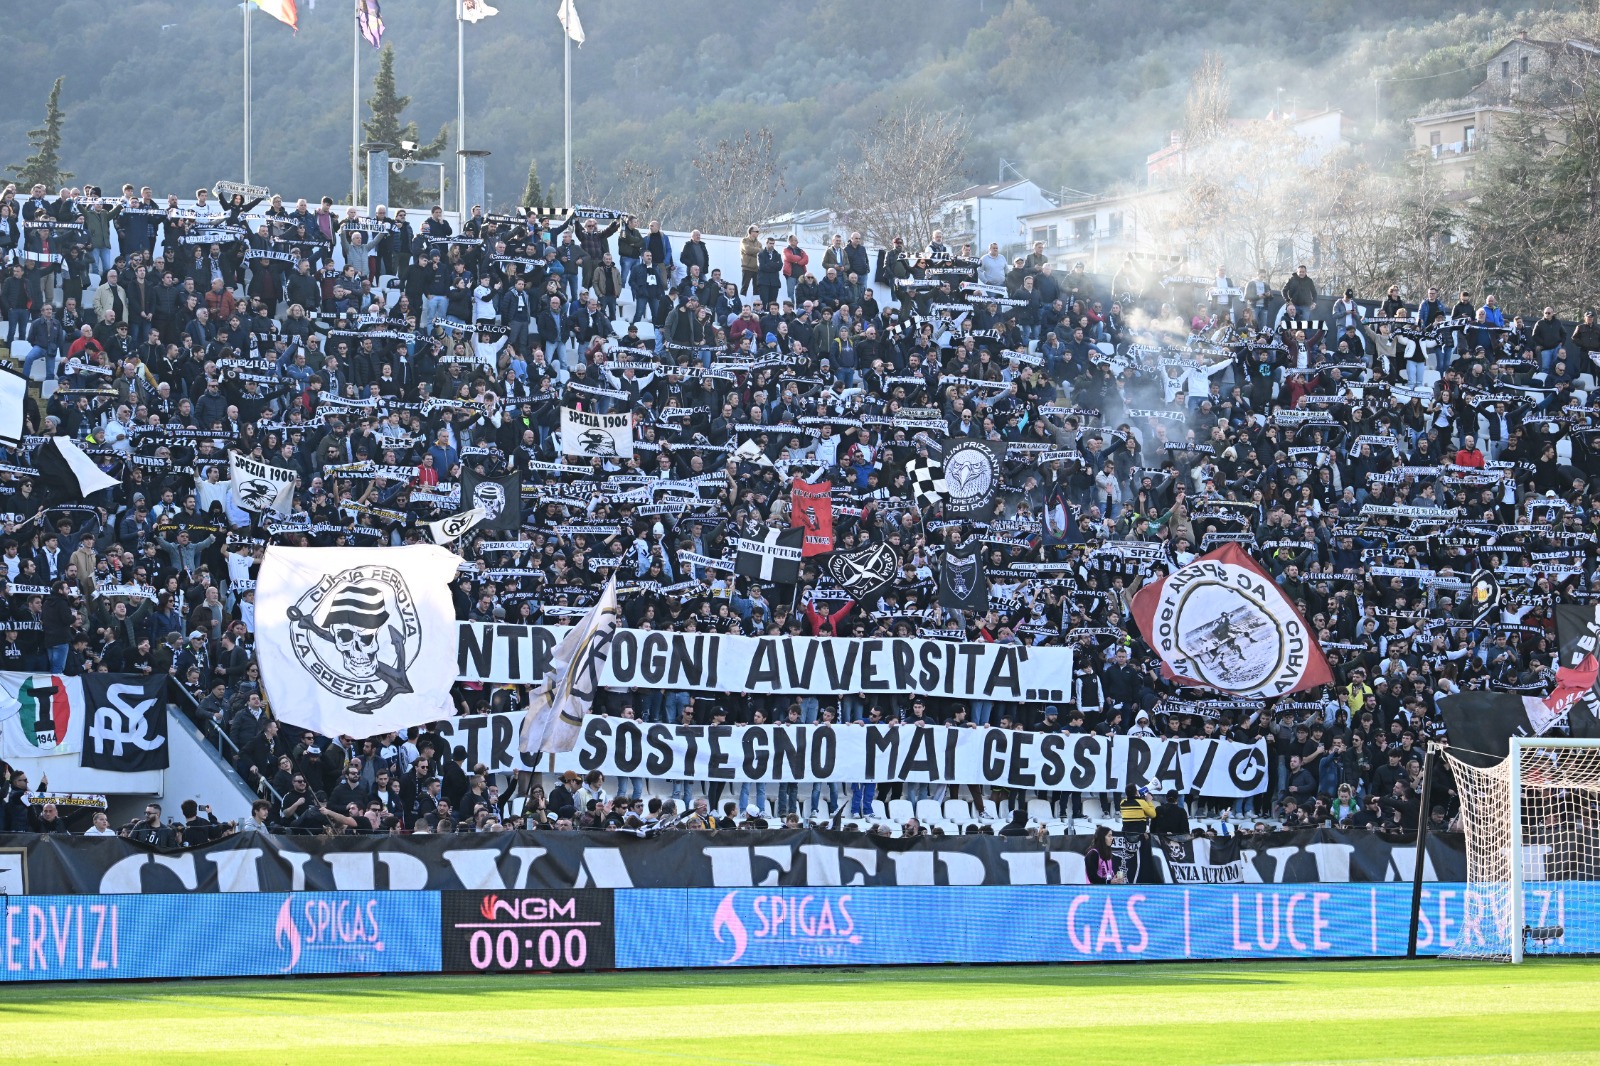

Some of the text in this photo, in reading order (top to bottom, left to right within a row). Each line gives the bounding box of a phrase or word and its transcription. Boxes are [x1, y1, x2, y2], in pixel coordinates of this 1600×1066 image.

[477, 325, 506, 333] CALCIO
[222, 359, 271, 369] SPEZIA
[239, 373, 278, 383] SPEZIA
[569, 411, 628, 428] SPEZIA 1906
[148, 438, 197, 447] SPEZIA
[133, 456, 164, 466] ULTRAS
[235, 456, 295, 482] SPEZIA 1906
[370, 465, 413, 474] SPEZIA
[530, 461, 556, 469] FORZA
[963, 441, 1000, 476] FRIZZANTI
[563, 484, 598, 495] SPEZIA
[952, 496, 981, 504] SPEZIA
[952, 488, 995, 512] DEI POETI
[741, 542, 802, 559] SENZA FUTURO
[1366, 549, 1407, 557] SPEZIA
[882, 552, 894, 578] SPEZIA
[371, 568, 418, 638] FERROVIA
[296, 633, 377, 696] LA SPEZIA
[612, 631, 720, 688] OGNI
[36, 732, 58, 745] 1944
[579, 717, 836, 780] SOSTEGNO
[866, 726, 958, 782] MAI
[494, 898, 576, 920] NGM
[753, 895, 854, 938] SPIGAS
[304, 900, 378, 944] SPIGAS
[1067, 894, 1149, 954] GAS
[1232, 892, 1331, 952] LUCE
[0, 904, 118, 971] ERVIZI
[470, 929, 588, 970] 00:00
